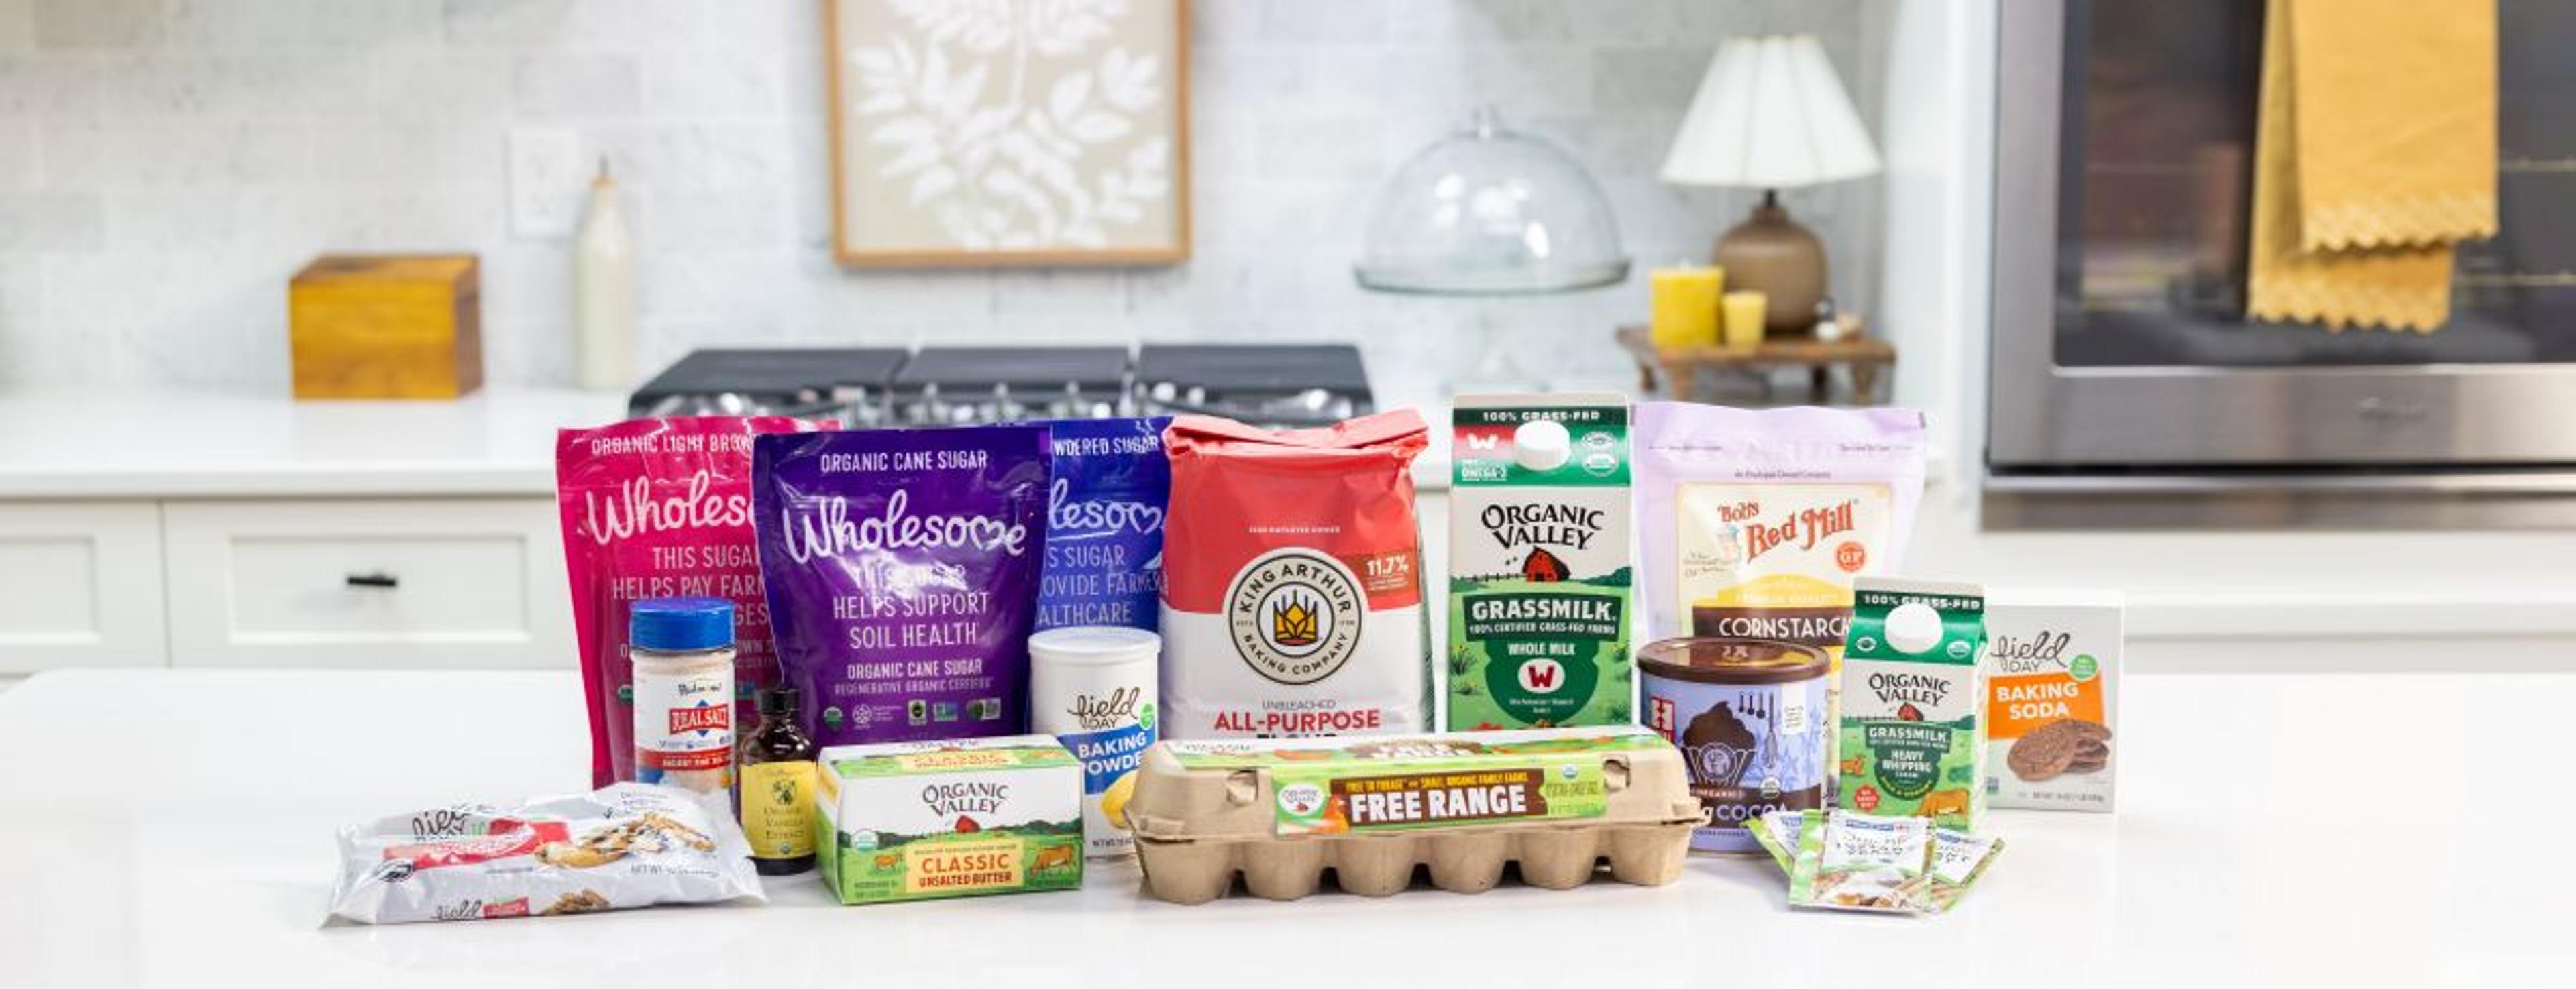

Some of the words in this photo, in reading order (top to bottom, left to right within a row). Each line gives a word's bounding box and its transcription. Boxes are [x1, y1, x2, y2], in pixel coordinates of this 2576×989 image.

[1483, 412, 1517, 422] 100%
[592, 436, 658, 455] ORGANIC
[663, 435, 704, 453] LIGHT
[1114, 435, 1160, 454] SUGAR
[820, 453, 888, 473] ORGANIC
[893, 451, 933, 470] CANE
[938, 450, 987, 469] SUGAR
[782, 489, 1026, 563] Wholesome
[1481, 504, 1604, 530] ORGANIC
[1492, 526, 1594, 550] VALLEY
[1746, 512, 1796, 565] Red
[1802, 500, 1854, 551] Mill
[653, 547, 696, 569] THIS
[1065, 545, 1125, 567] SUGAR
[1366, 556, 1409, 577] 11.7%
[613, 577, 672, 599] HELPS
[681, 576, 712, 598] PAY
[1239, 571, 1276, 613] KING
[1281, 564, 1352, 613] ARTHUR
[833, 595, 896, 619] HELPS
[903, 592, 989, 616] SUPPORT
[1472, 600, 1613, 621] GRASSMILK
[1863, 594, 1899, 605] 100%
[850, 627, 896, 649] SOIL
[1508, 642, 1546, 655] WHOLE
[1549, 642, 1576, 655] MILK
[1244, 634, 1286, 673] BAKING
[1292, 632, 1348, 675] COMPANY
[1990, 630, 2071, 671] field
[847, 662, 904, 680] ORGANIC
[908, 660, 940, 677] CANE
[944, 658, 983, 675] SUGAR
[1528, 665, 1555, 687] W
[2009, 660, 2041, 672] DAY
[1868, 673, 1951, 695] ORGANIC
[1996, 682, 2079, 703] BAKING
[1067, 687, 1140, 729] field
[1262, 699, 1336, 710] UNBLEACHED
[1876, 690, 1944, 707] VALLEY
[1214, 709, 1381, 732] ALL-PURPOSE
[2008, 701, 2070, 720] SODA
[1088, 717, 1119, 729] DAY
[1079, 732, 1147, 758] BAKING
[1869, 727, 1947, 743] GRASSMILK
[1891, 750, 1924, 761] HEAVY
[923, 782, 1009, 804] ORGANIC
[929, 799, 1002, 818] VALLEY
[1350, 790, 1423, 825] FREE
[1428, 784, 1527, 819] RANGE
[922, 854, 1010, 874] CLASSIC
[919, 874, 971, 888] UNSALTED
[973, 871, 1012, 885] BUTTER
